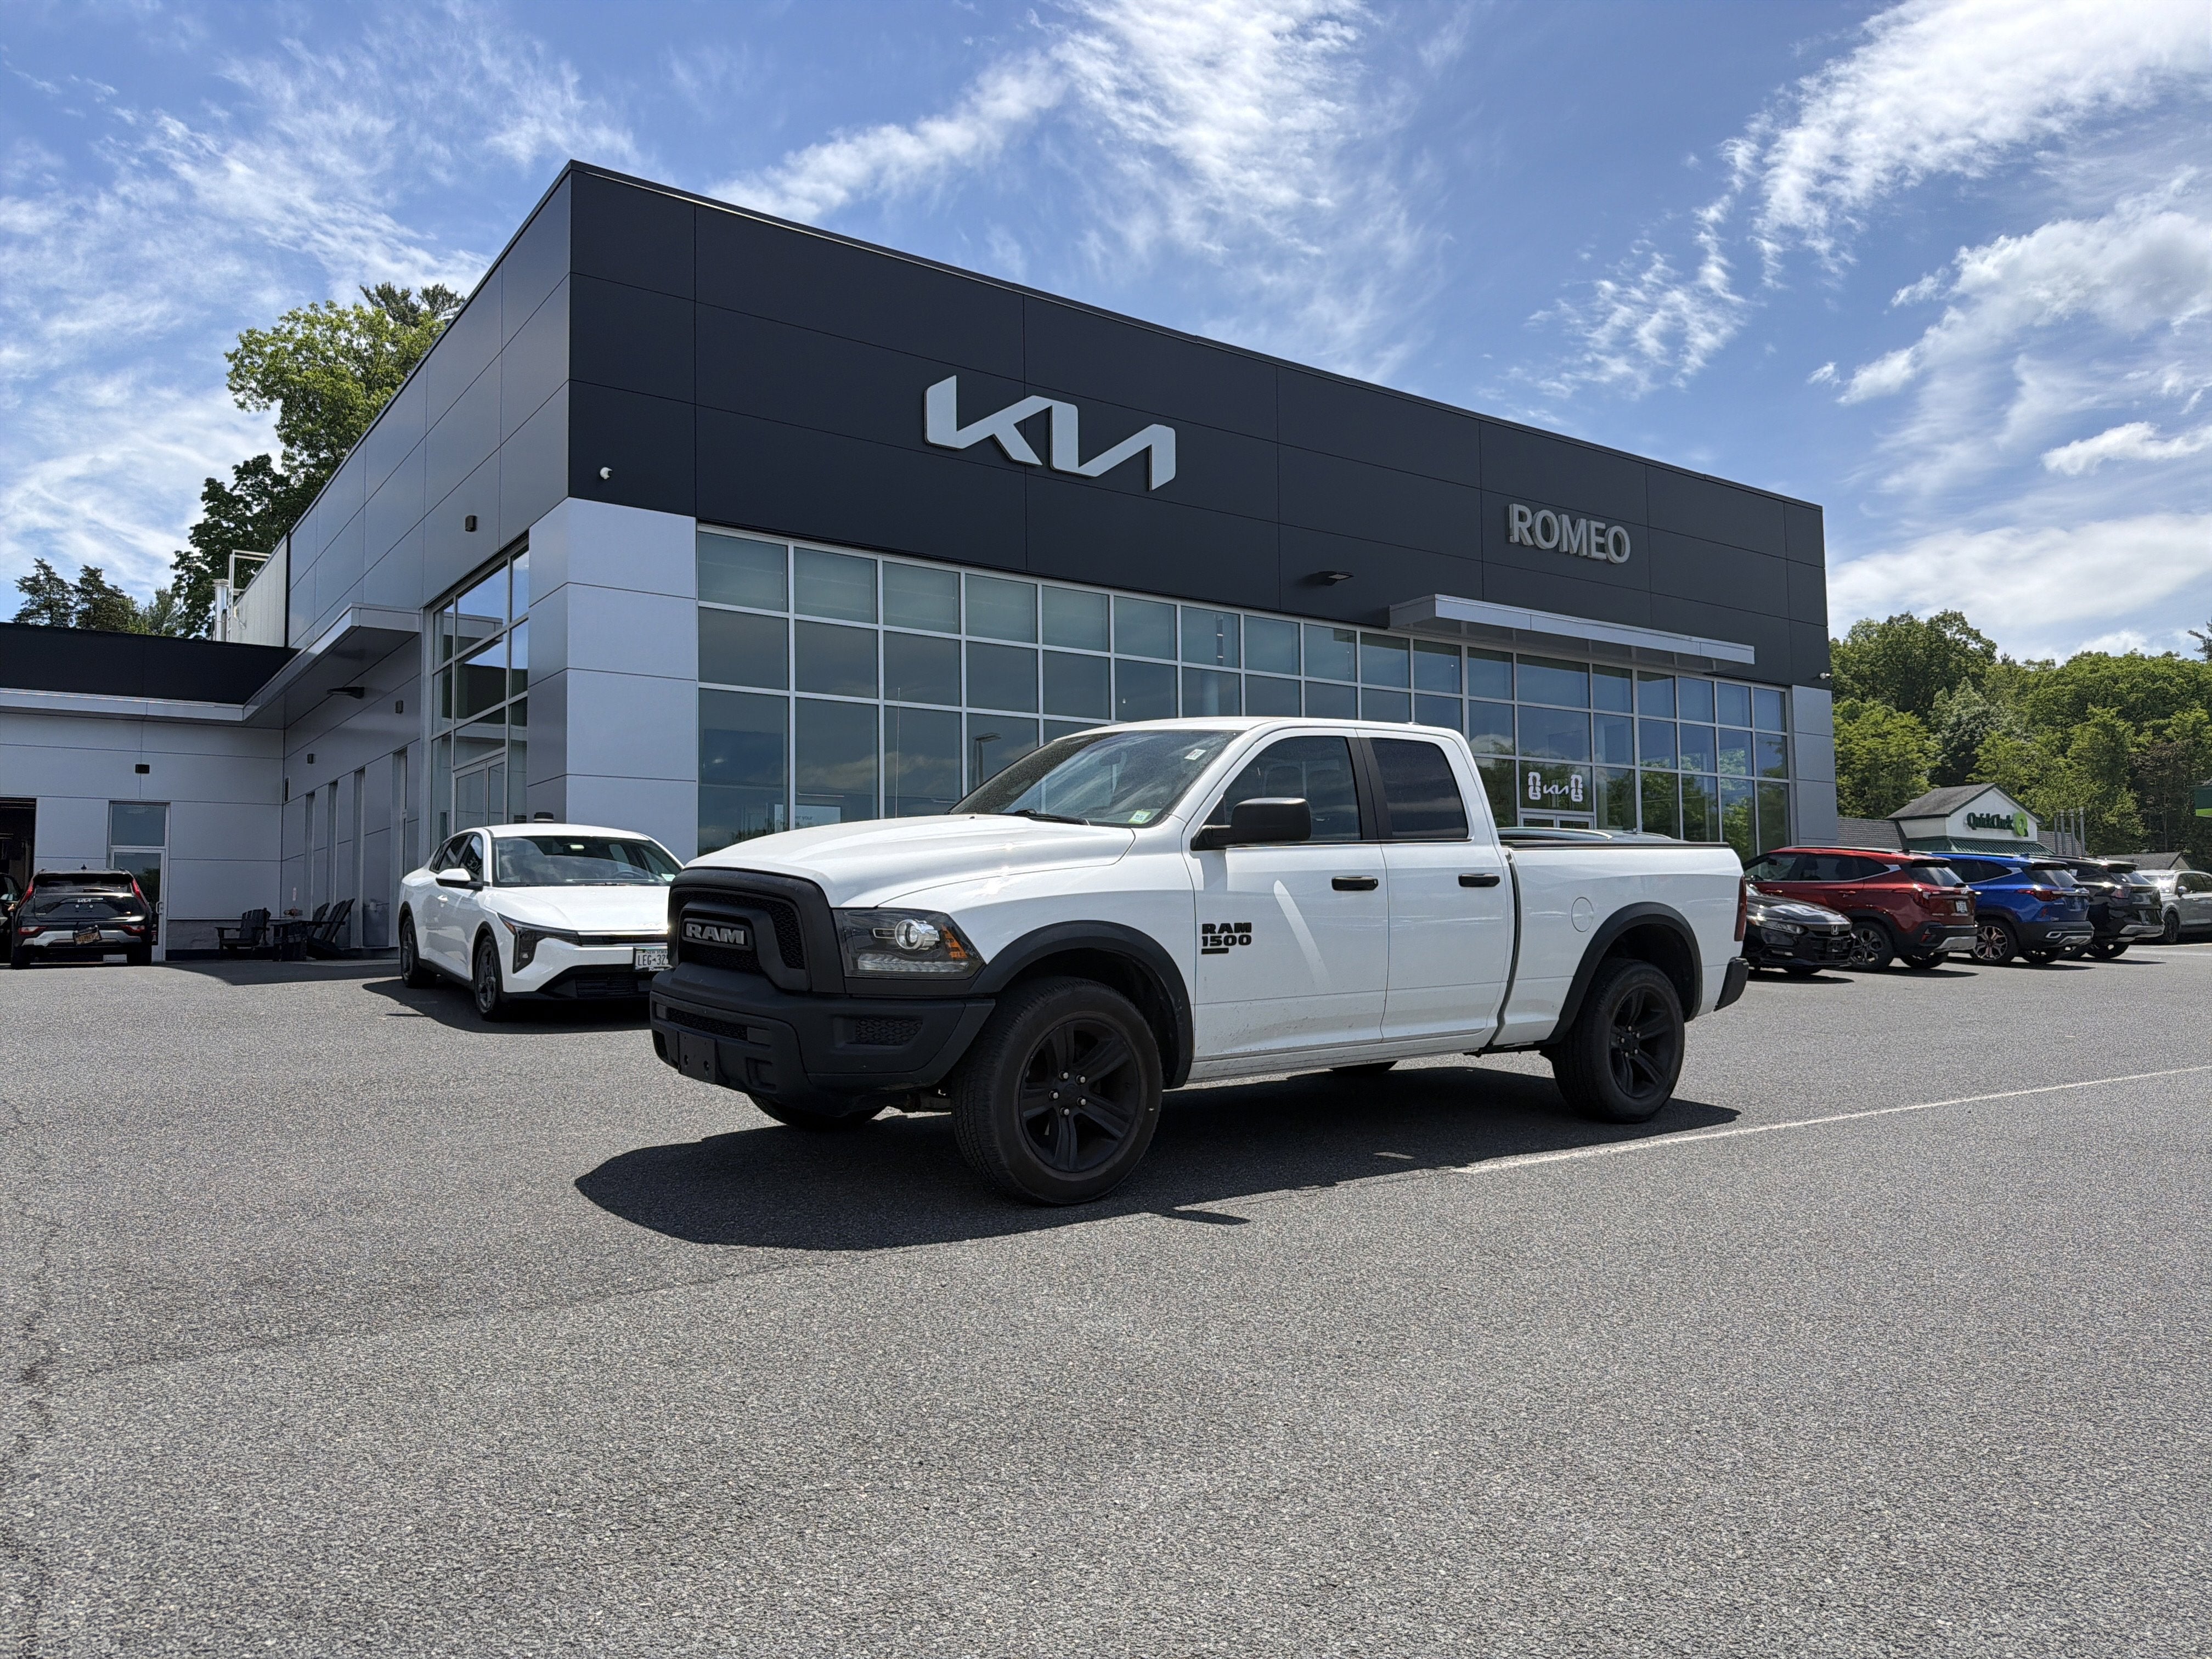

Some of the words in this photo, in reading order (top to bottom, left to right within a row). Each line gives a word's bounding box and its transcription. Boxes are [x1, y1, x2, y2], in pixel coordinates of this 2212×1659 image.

[1509, 503, 1631, 564] ROMEO
[686, 923, 745, 945] RAM
[1201, 922, 1252, 934] RAM
[1201, 934, 1252, 947] 1500
